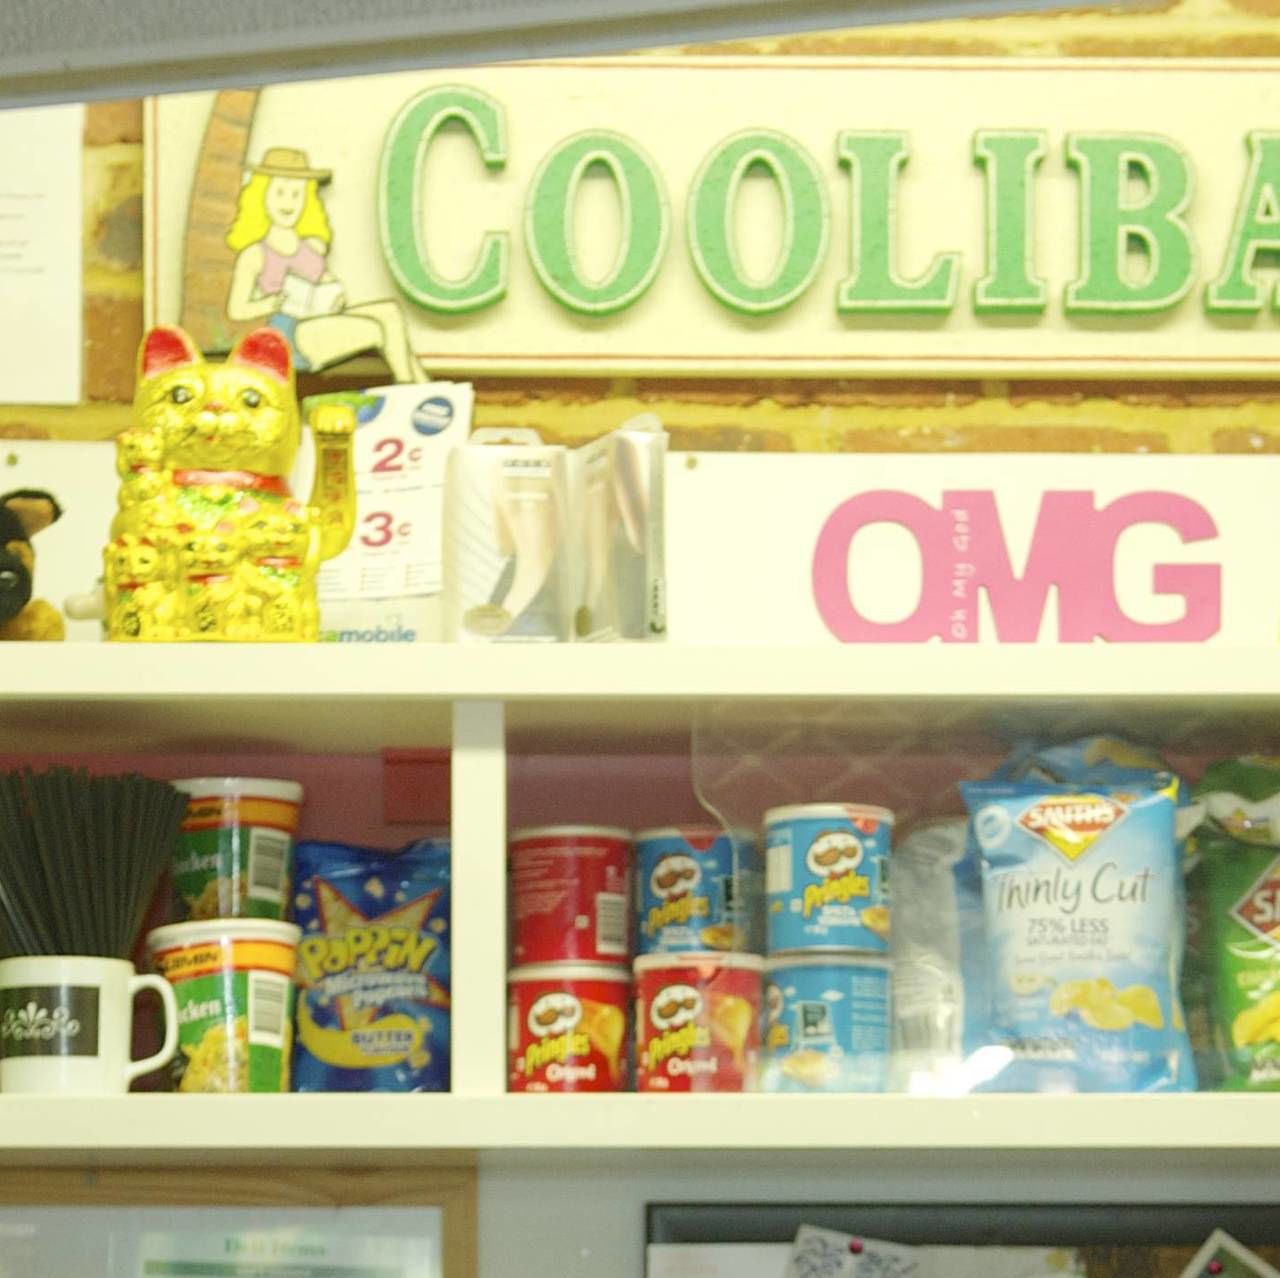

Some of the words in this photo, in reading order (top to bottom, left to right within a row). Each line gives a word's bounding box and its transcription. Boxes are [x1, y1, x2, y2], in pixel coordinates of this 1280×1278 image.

[811, 489, 1222, 643] OMG
[319, 625, 417, 643] amobile
[992, 867, 1083, 915] Thinly
[1090, 862, 1156, 906] Cut
[1027, 917, 1066, 935] 75%
[1070, 918, 1110, 935] LESS
[524, 1031, 592, 1075] Pringles
